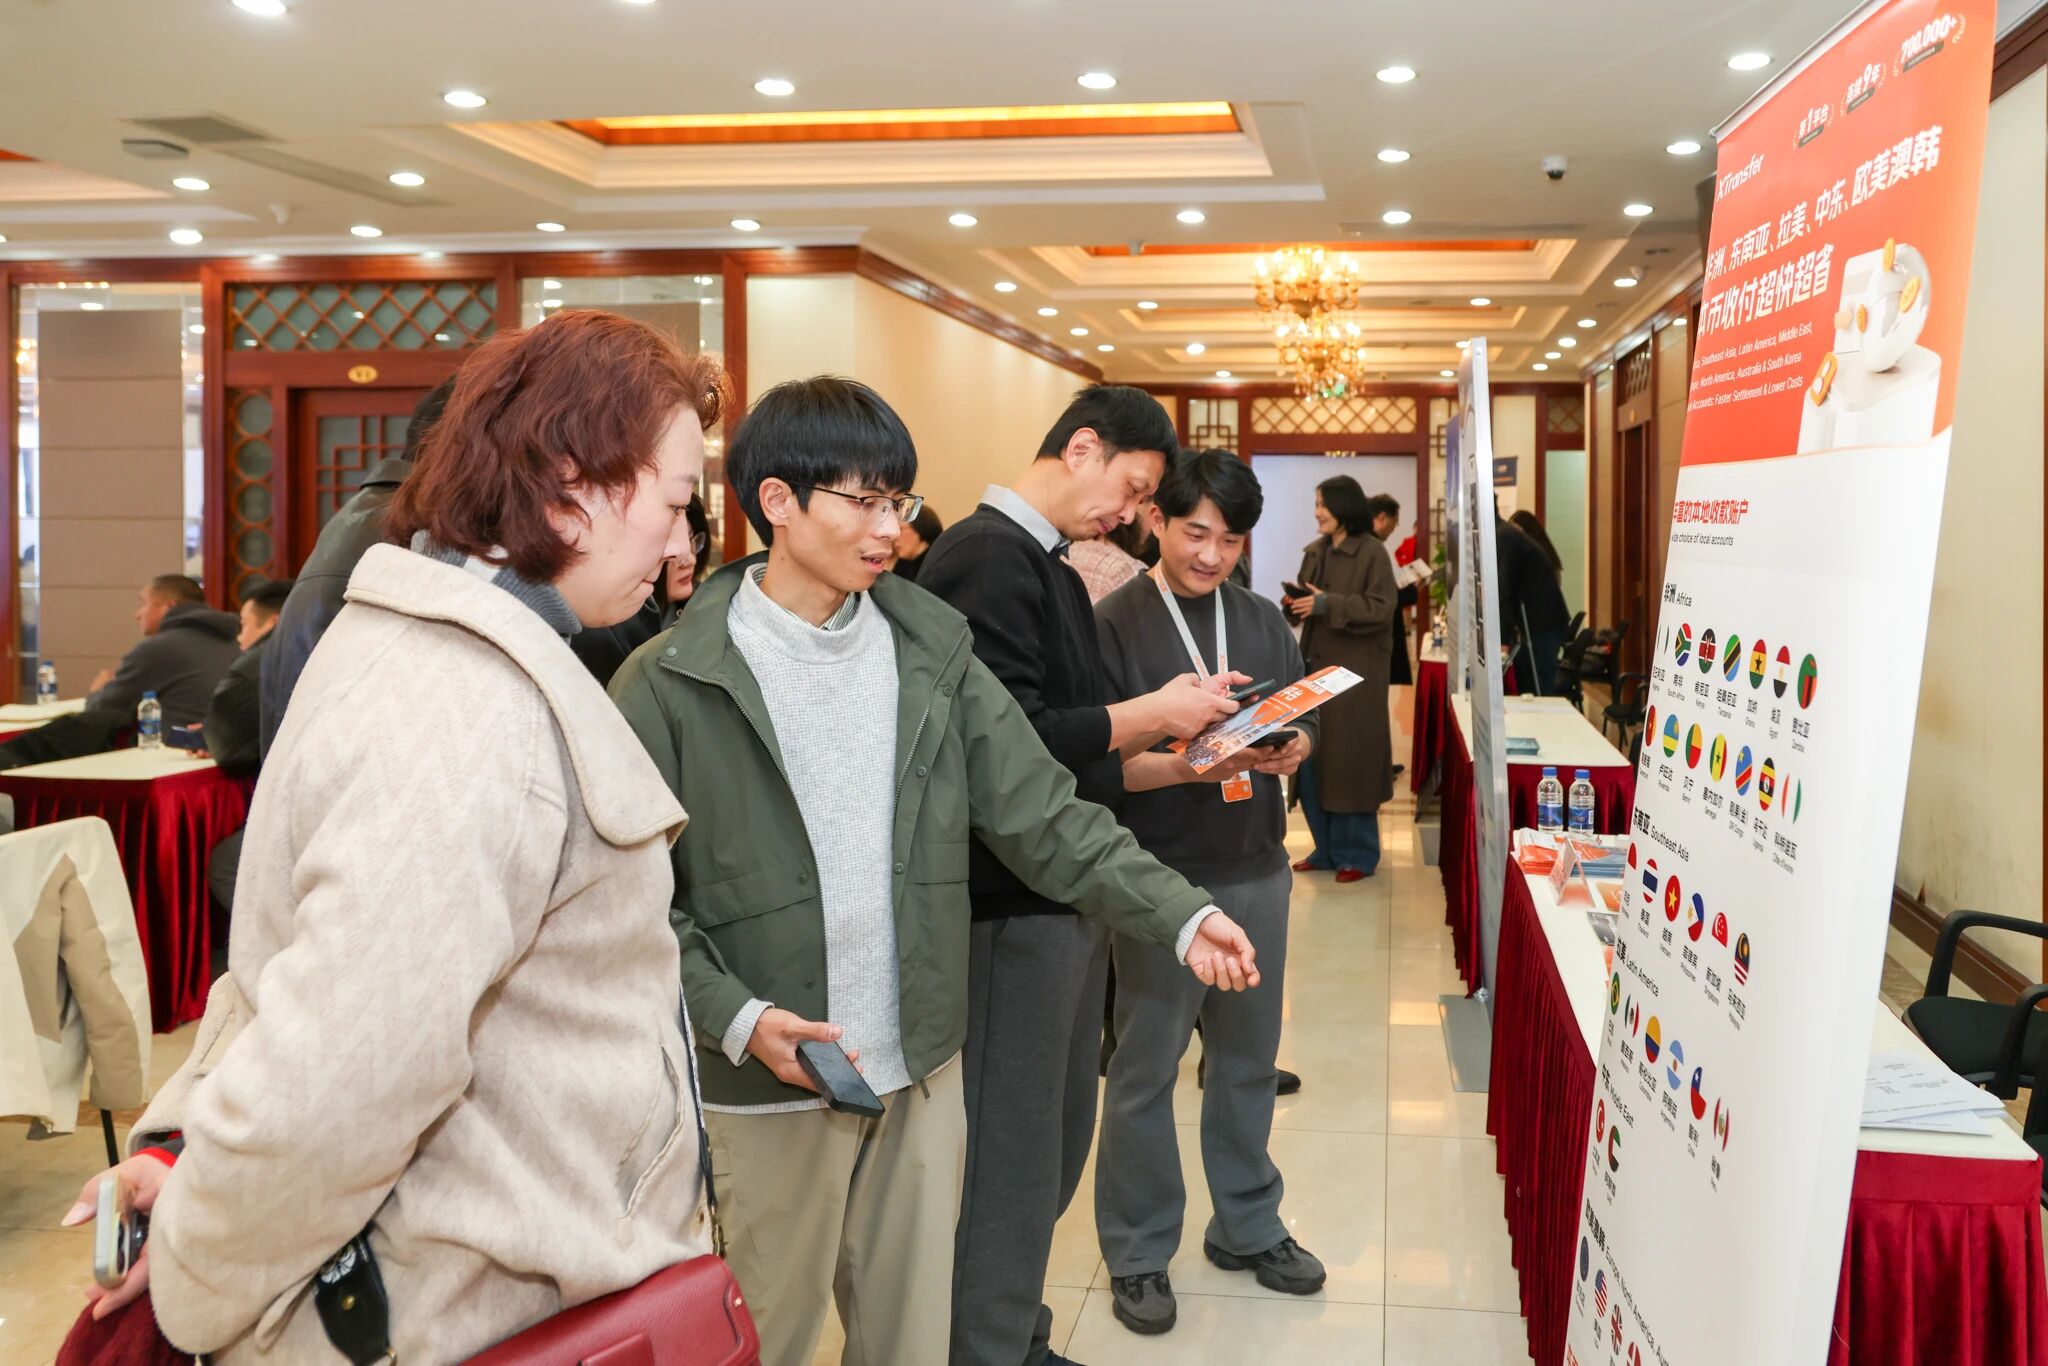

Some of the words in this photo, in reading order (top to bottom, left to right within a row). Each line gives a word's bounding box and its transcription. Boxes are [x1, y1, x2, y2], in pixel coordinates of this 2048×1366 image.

[1716, 153, 1765, 202] XTransfer
[1701, 350, 1724, 366] Southeast
[1738, 342, 1753, 356] Latin
[1754, 336, 1777, 351] America,
[1778, 326, 1799, 343] Middle
[1737, 363, 1762, 379] Australia
[1767, 357, 1784, 371] South
[1785, 352, 1802, 367] Korea
[1715, 392, 1733, 405] Faster
[1733, 385, 1763, 402] Settlement
[1768, 380, 1786, 395] Lower
[1787, 375, 1804, 390] Costs
[1679, 532, 1693, 543] choice
[1693, 532, 1699, 543] of
[1699, 533, 1711, 545] local
[1711, 535, 1734, 546] accounts
[1676, 592, 1692, 607] Africa
[1633, 805, 1650, 836] 东南亚
[1650, 825, 1677, 857] Southeast
[1677, 843, 1689, 862] Asia
[1626, 954, 1638, 977] Latin
[1638, 968, 1659, 998] America
